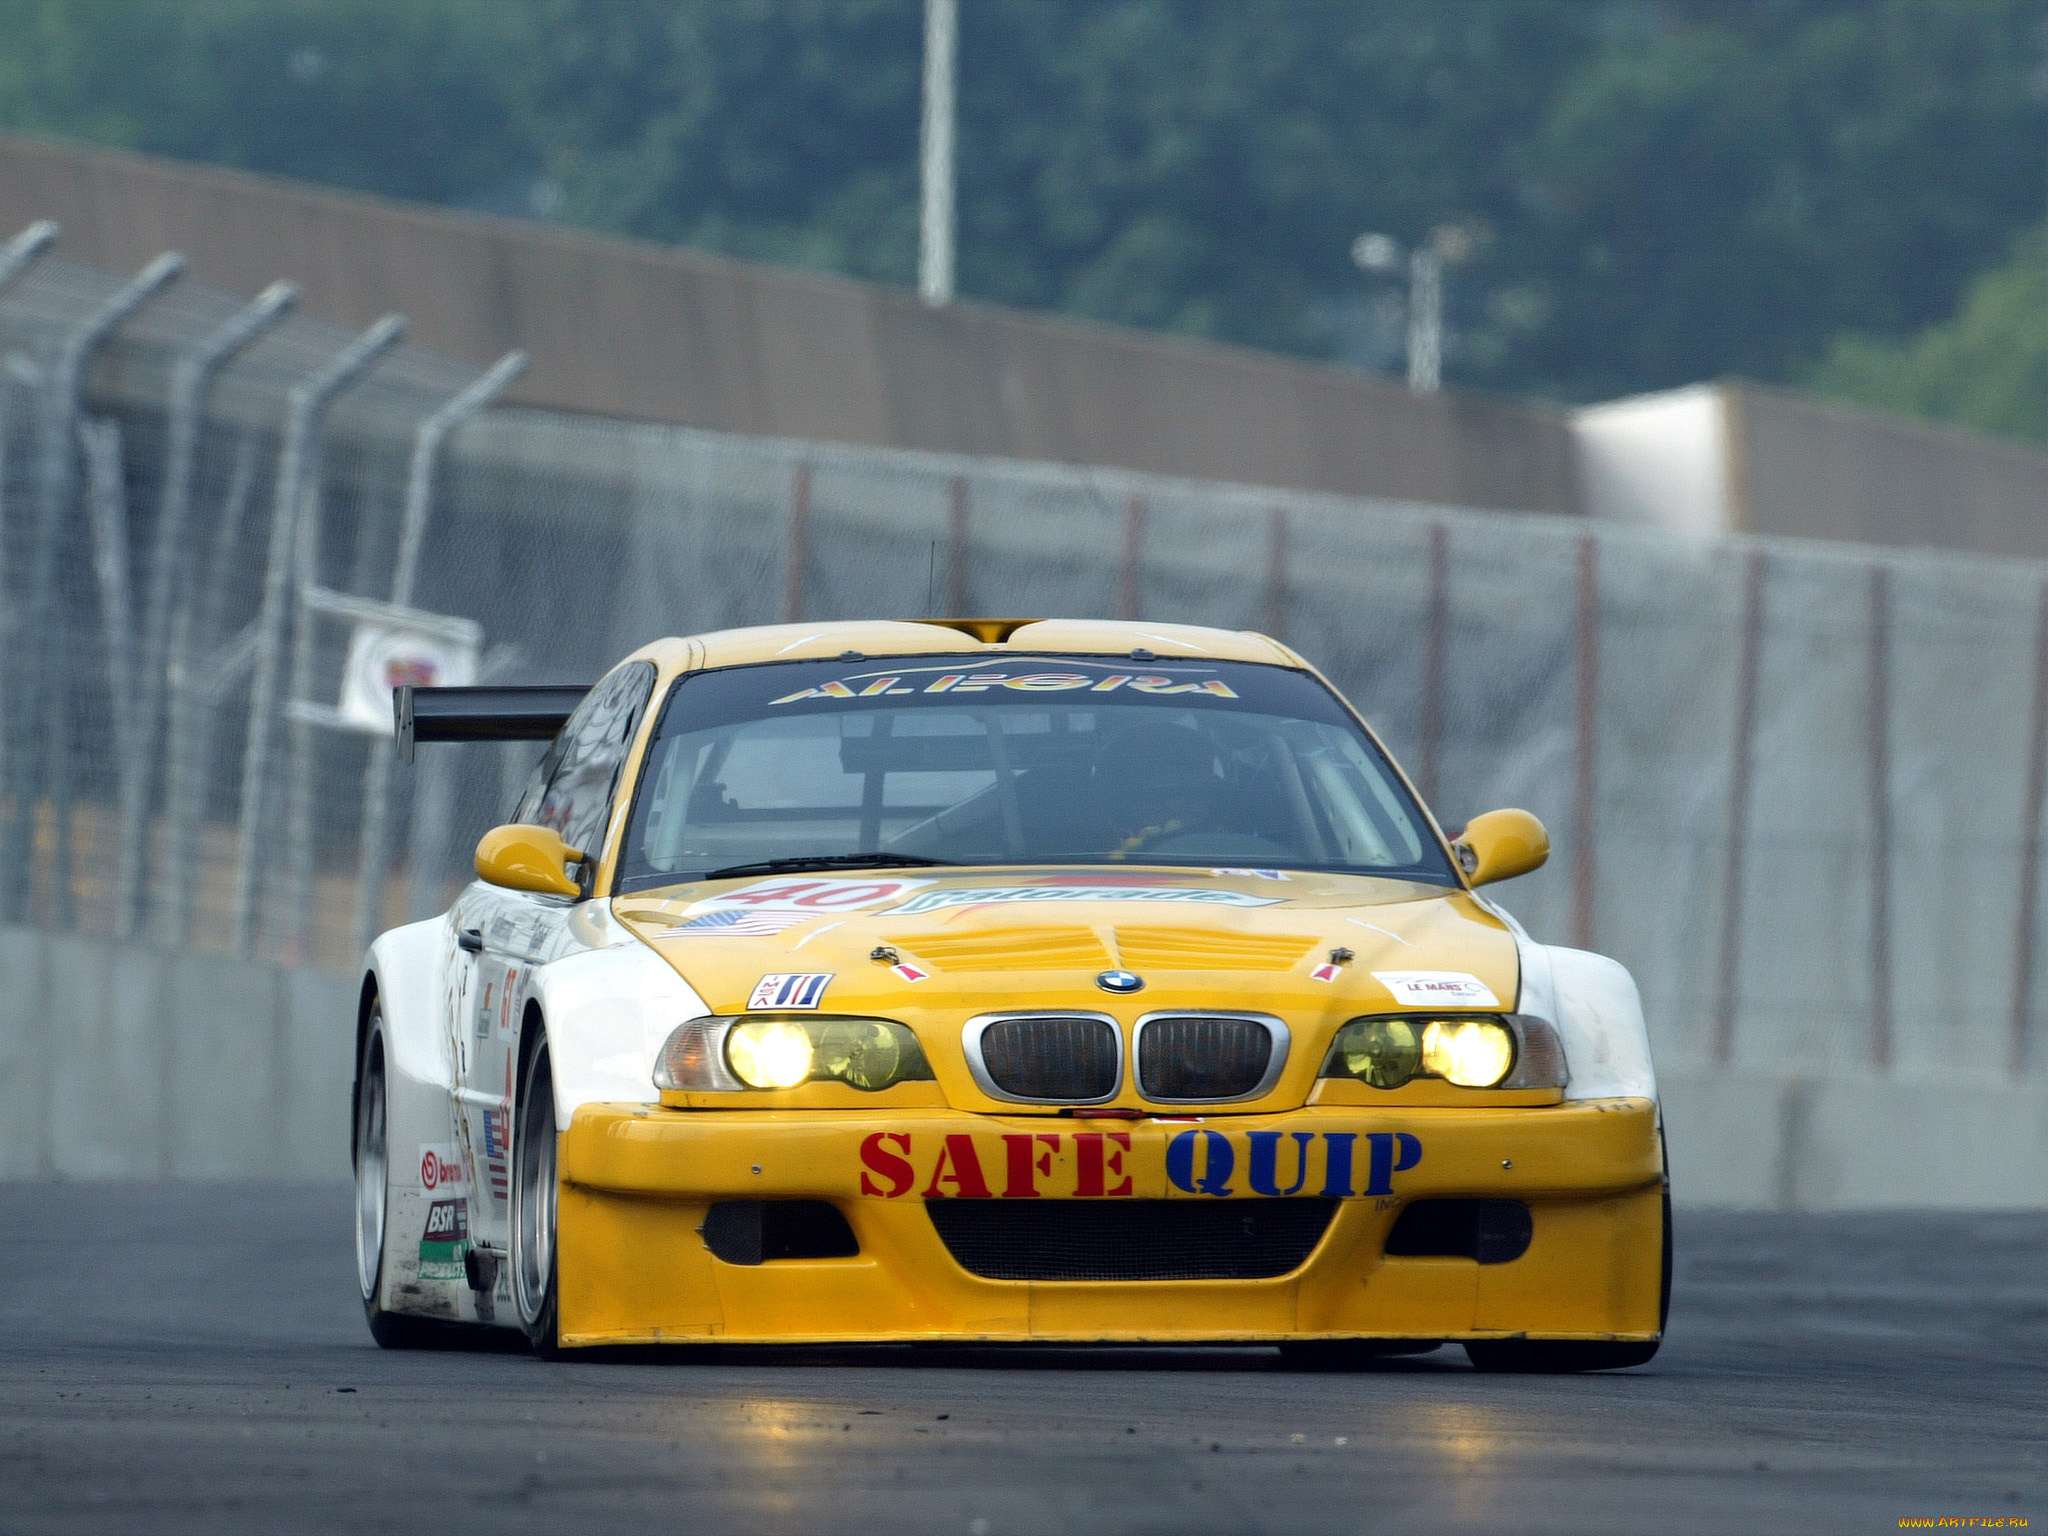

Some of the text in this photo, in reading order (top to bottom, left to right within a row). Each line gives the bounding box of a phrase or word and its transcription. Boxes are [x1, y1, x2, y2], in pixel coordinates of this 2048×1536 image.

[768, 673, 1240, 705] ALEGRA
[720, 883, 902, 906] 40
[1425, 983, 1463, 991] MANS
[859, 1129, 1423, 1198] SAFE QUIP
[427, 1205, 455, 1233] BSR
